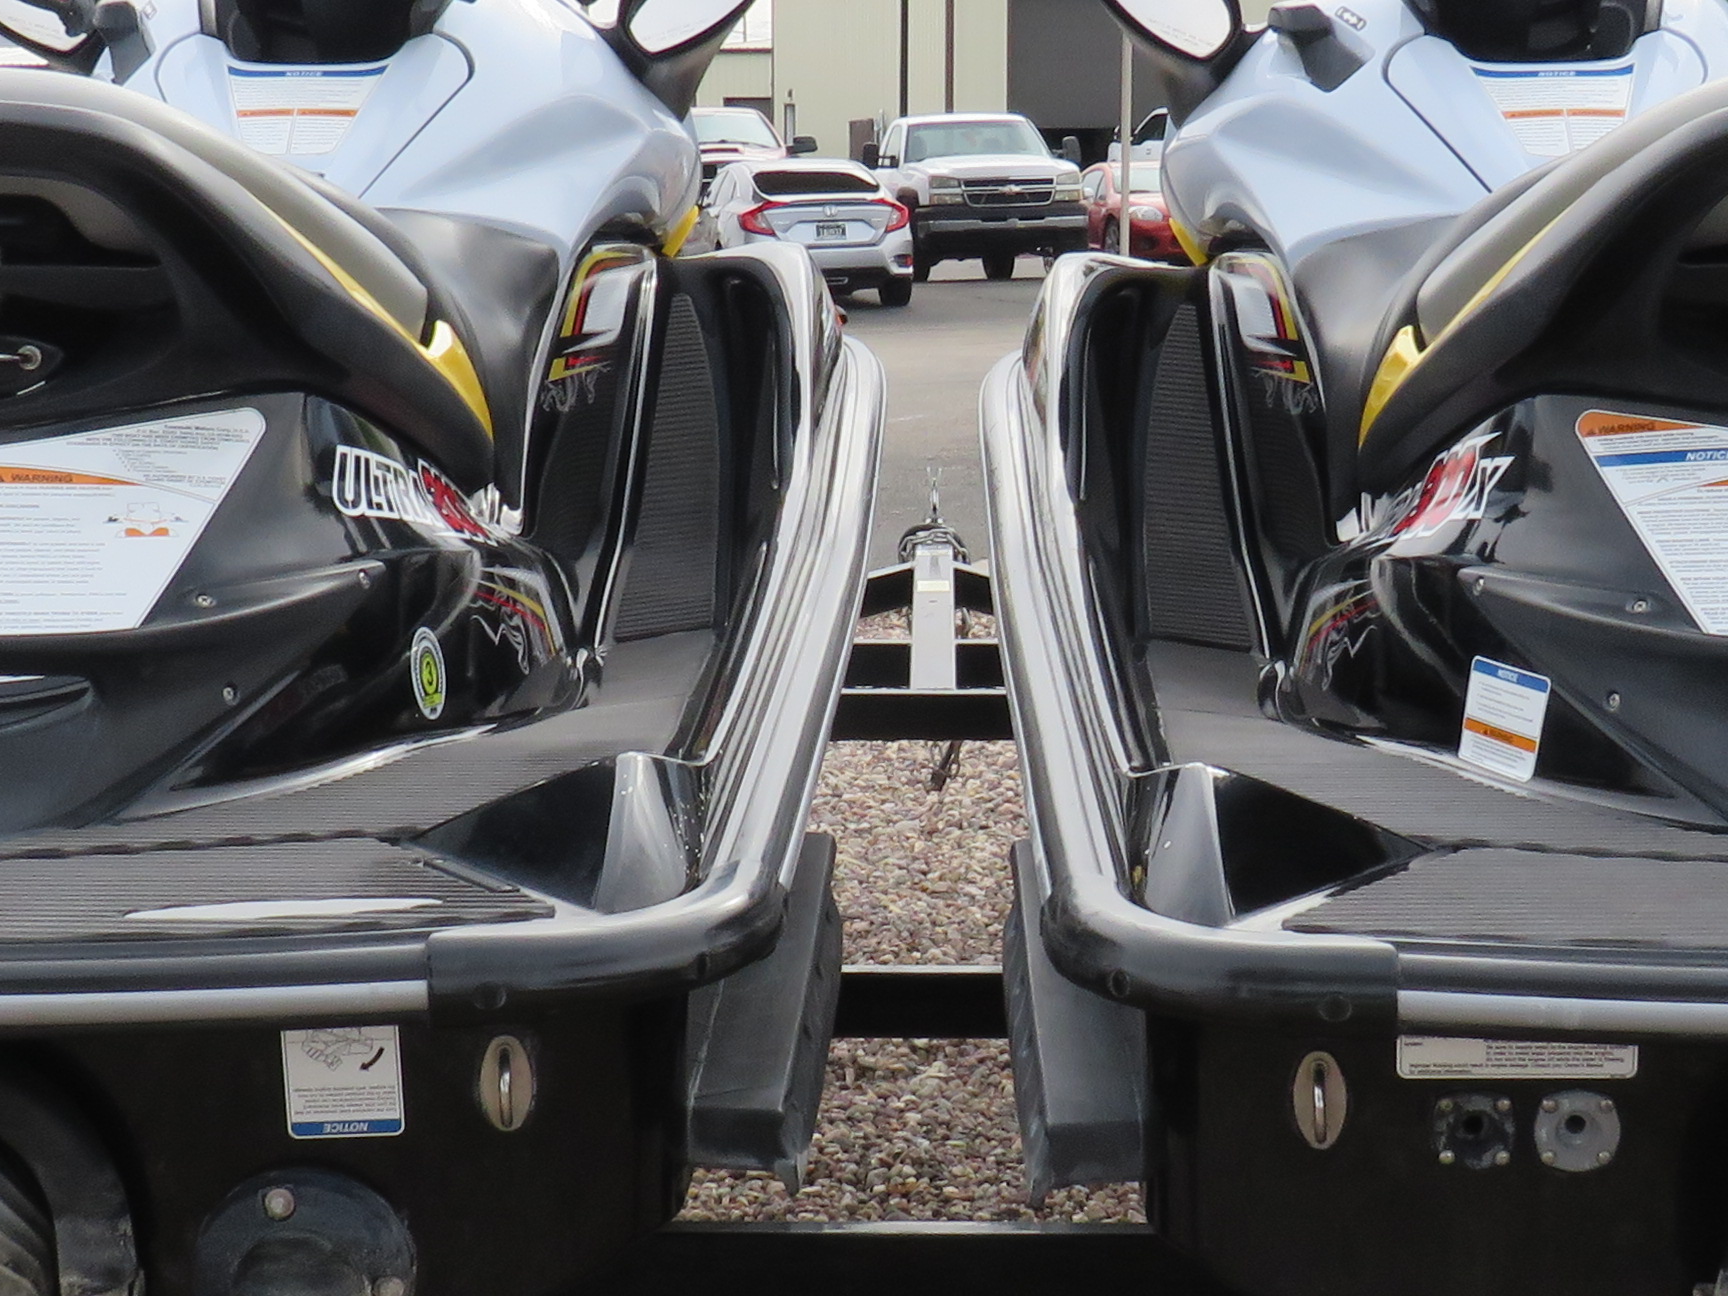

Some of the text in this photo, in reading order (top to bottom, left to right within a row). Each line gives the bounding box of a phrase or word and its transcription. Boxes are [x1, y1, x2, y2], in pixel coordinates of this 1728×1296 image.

[1598, 421, 1656, 435] WARNING
[10, 472, 73, 483] WARNING
[323, 1121, 369, 1133] NOTICE
